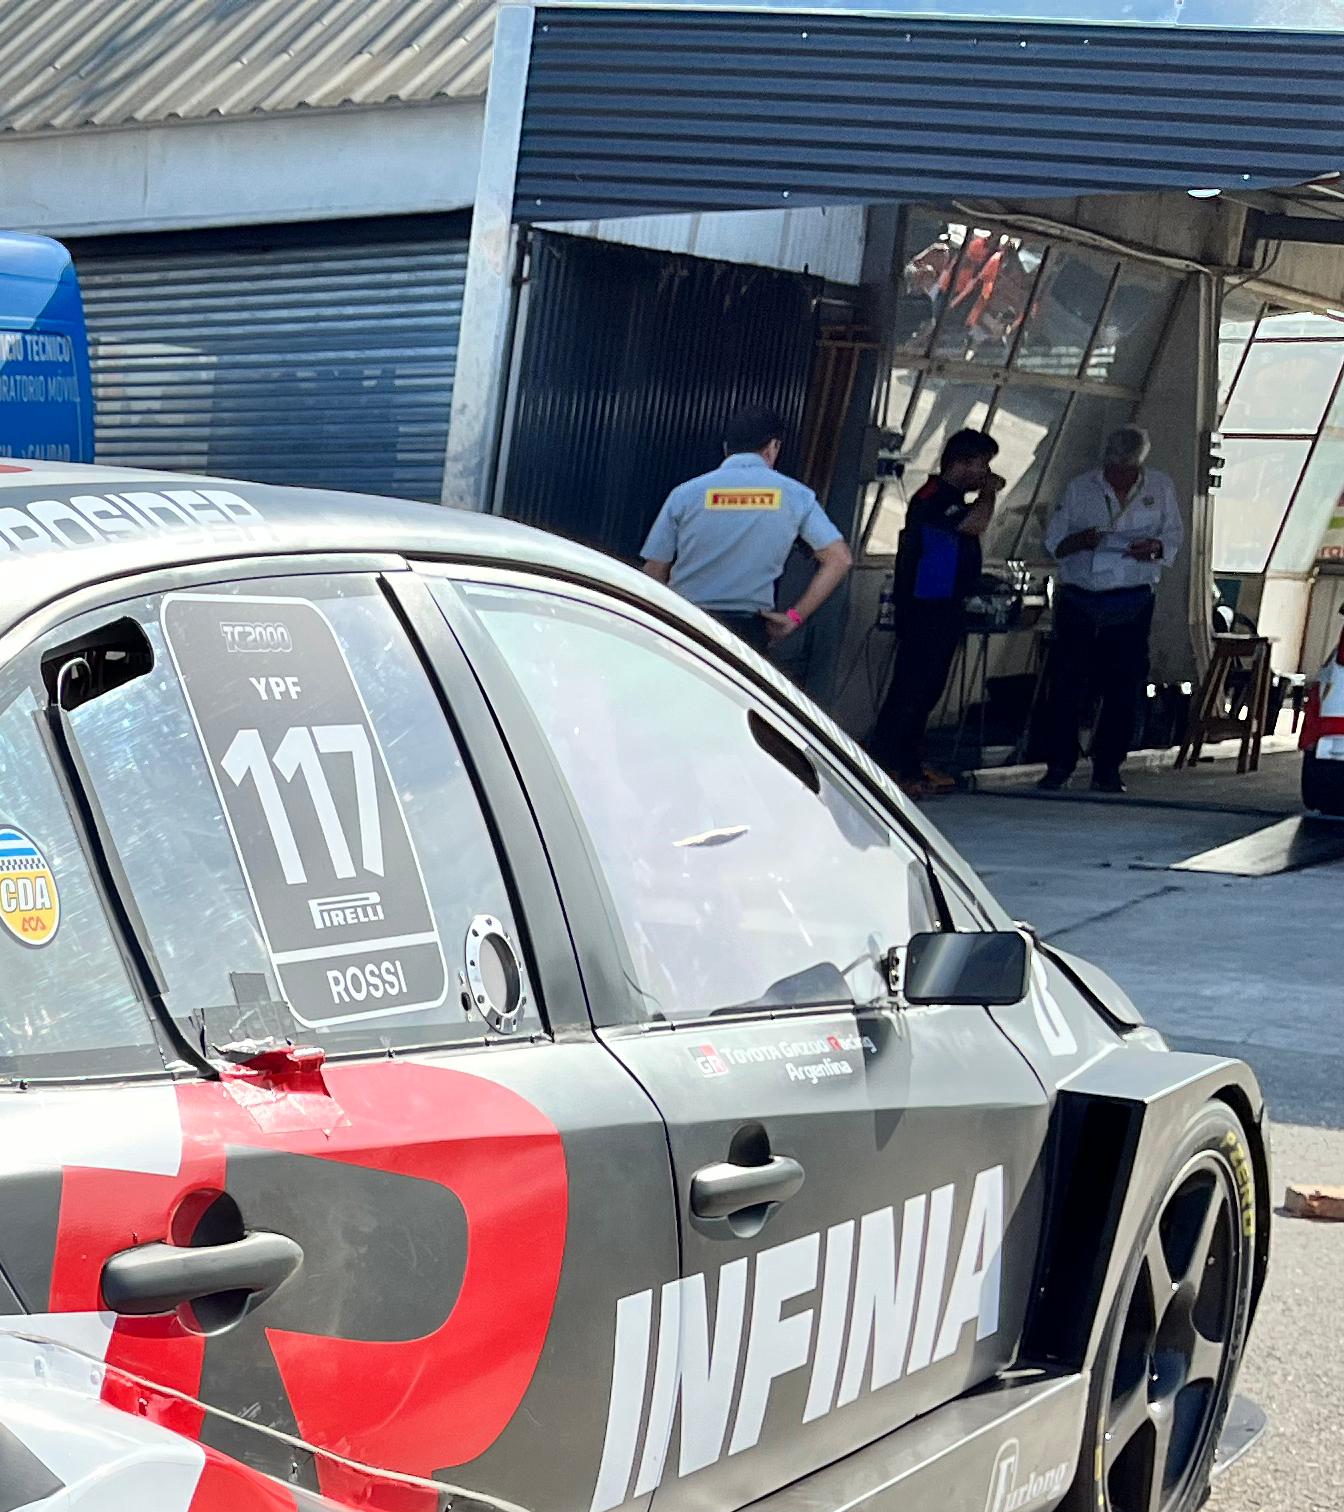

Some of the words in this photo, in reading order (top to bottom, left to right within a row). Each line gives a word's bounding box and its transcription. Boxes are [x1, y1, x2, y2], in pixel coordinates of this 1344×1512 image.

[219, 621, 293, 653] TC2000
[249, 676, 302, 701] YPF
[220, 724, 385, 886] 117
[0, 876, 53, 914] CDA
[307, 891, 385, 930] PIRELLI
[326, 960, 408, 1005] ROSSI
[827, 1034, 877, 1053] Racing
[785, 1057, 853, 1084] Argentina
